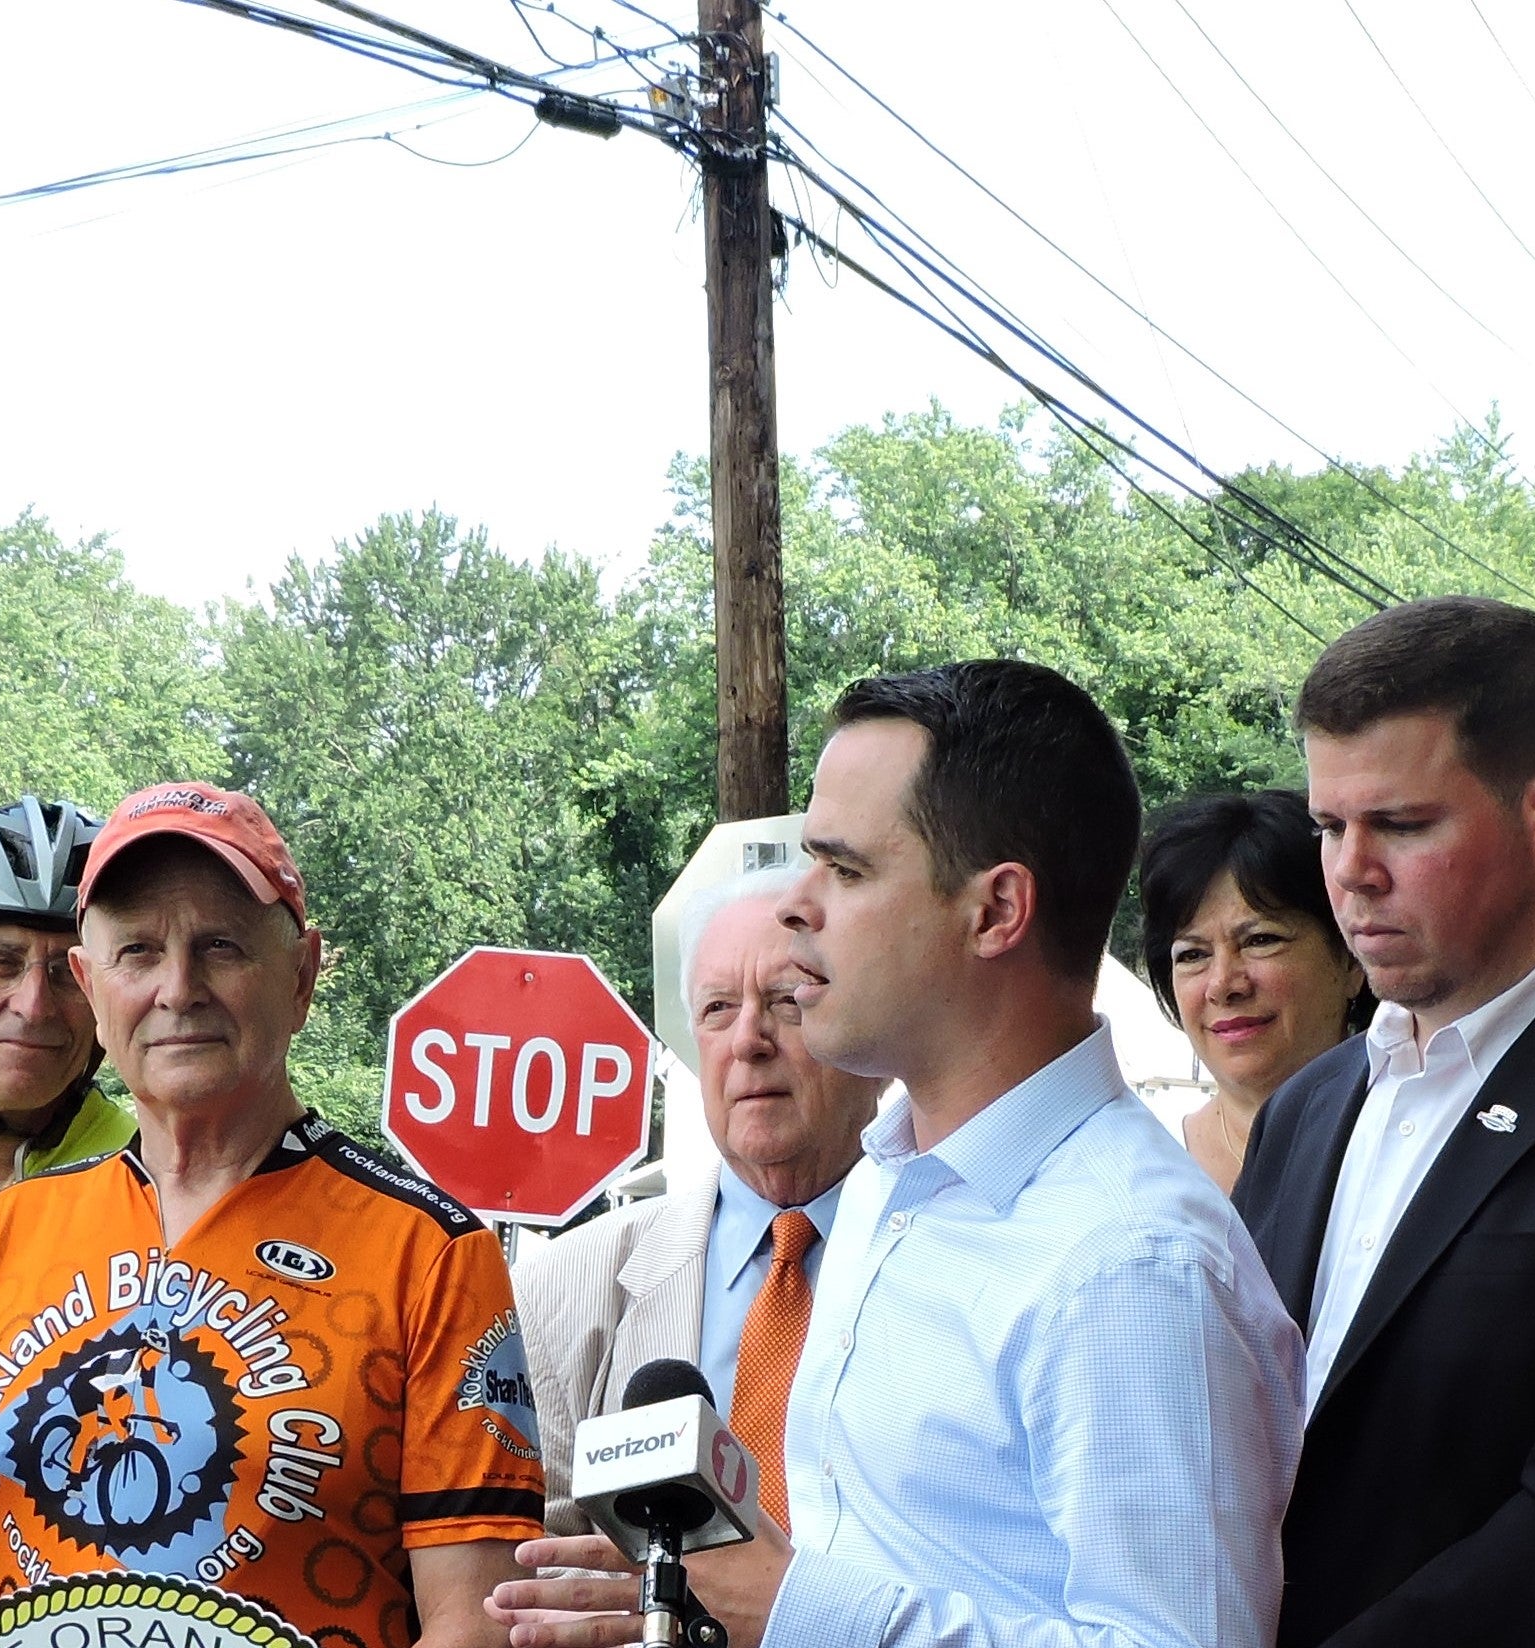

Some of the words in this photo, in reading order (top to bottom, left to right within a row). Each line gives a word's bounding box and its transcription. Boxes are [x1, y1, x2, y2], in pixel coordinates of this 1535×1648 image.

[404, 1028, 634, 1136] STOP
[338, 1144, 468, 1224] rocklandbike.org
[107, 1247, 310, 1398] Bicycling
[256, 1407, 344, 1524] Club
[457, 1312, 508, 1413] Rockland
[586, 1430, 676, 1465] verizon
